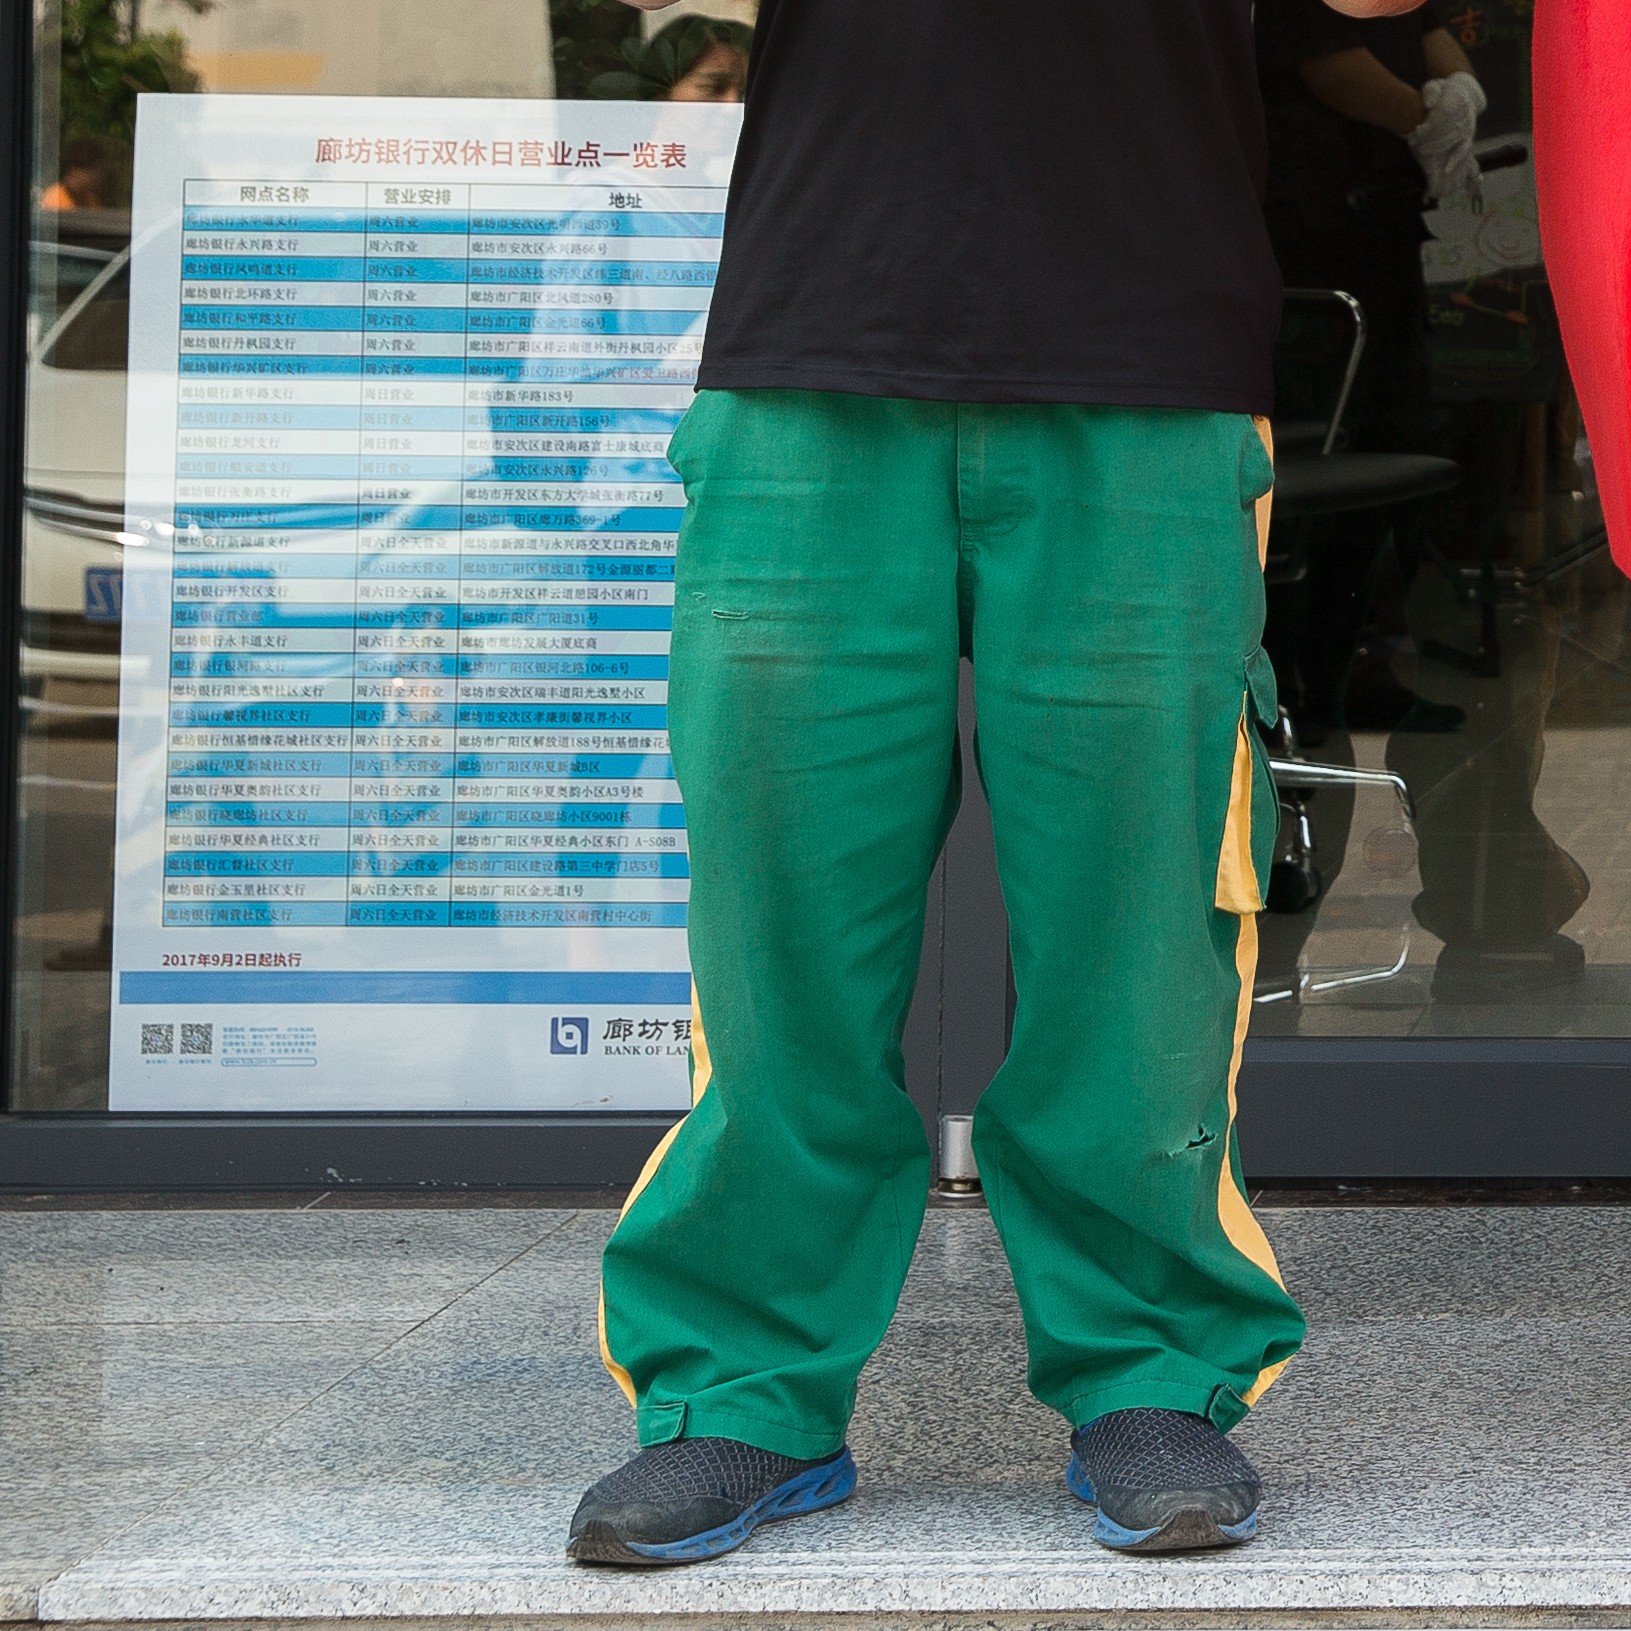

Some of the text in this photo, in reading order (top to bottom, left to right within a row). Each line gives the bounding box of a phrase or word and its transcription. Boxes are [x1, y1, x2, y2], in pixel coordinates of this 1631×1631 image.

[315, 137, 688, 170] 廊坊银行双休日营业点一览表
[240, 186, 643, 209] 网点名称 营业安排 地址
[369, 217, 418, 229] 周六营业
[368, 240, 418, 253] 周六营业
[368, 266, 417, 278] 周六营业
[367, 289, 417, 302] 周六营业
[366, 314, 416, 327] 周六营业
[366, 339, 416, 352] 周六营业
[365, 363, 415, 376] 周六营业
[364, 388, 414, 401] 周日营业
[364, 413, 413, 425] 周日营业
[363, 438, 412, 450] 周日营业
[362, 462, 412, 475] 周日营业
[361, 487, 412, 500] 周日营业
[361, 512, 411, 525] 周日营业
[360, 536, 447, 549] 周六日全天营业
[359, 561, 447, 574] 周六日全天营业
[358, 586, 447, 599] 周六日全天营业
[358, 610, 446, 623] 周六日全天营业
[358, 635, 445, 648] 周六日全天营业
[357, 660, 444, 673] 周六日全天营业
[356, 685, 444, 698] 周六日全天营业
[356, 709, 443, 722] 周六日全天营业
[355, 734, 443, 748] 周六日全天营业
[354, 759, 441, 772] 周六日全天营业
[353, 784, 441, 797] 周六日全天营业
[353, 809, 440, 822] 周六日全天营业
[352, 834, 439, 847] 周六日全天营业
[351, 859, 439, 871] 周六日全天营业
[350, 884, 438, 896] 周六日全天营业
[350, 908, 437, 921] 周六日全天营业
[162, 953, 302, 968] 2017年9月2日起执行
[604, 1045, 641, 1056] BANK
[645, 1046, 663, 1056] OF
